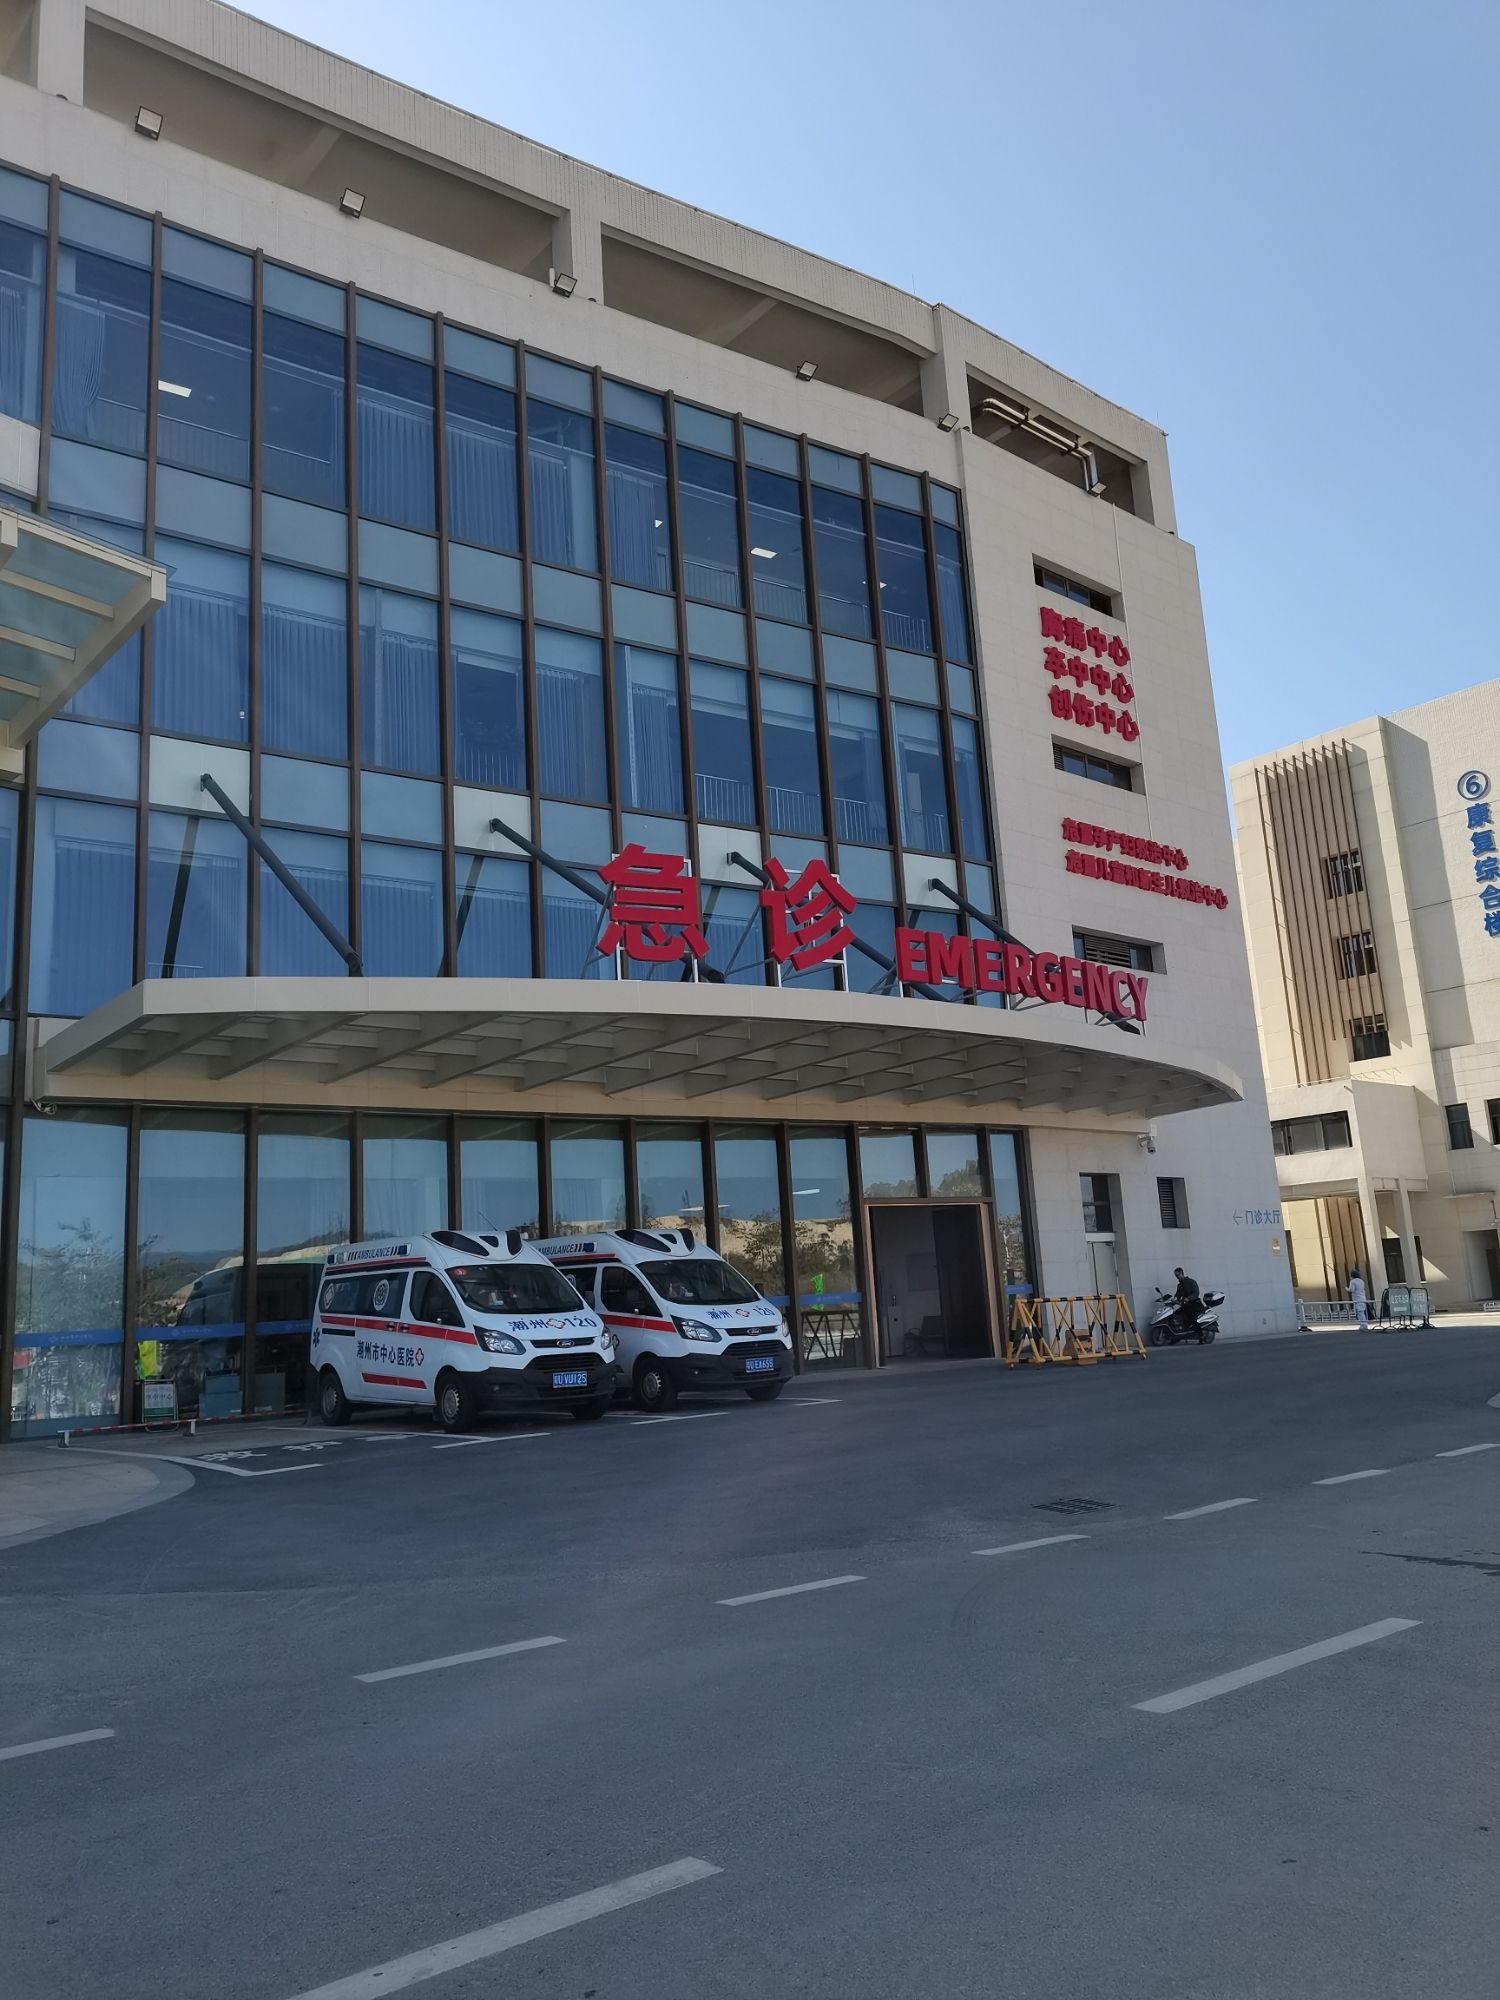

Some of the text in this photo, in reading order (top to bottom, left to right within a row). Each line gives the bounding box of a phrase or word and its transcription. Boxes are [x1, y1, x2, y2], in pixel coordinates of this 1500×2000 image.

[1048, 685, 1140, 741] 创伤中心
[597, 843, 1149, 1022] 急诊 EMERGENCY
[1245, 1209, 1280, 1224] 门诊大厅
[564, 1315, 597, 1327] 120
